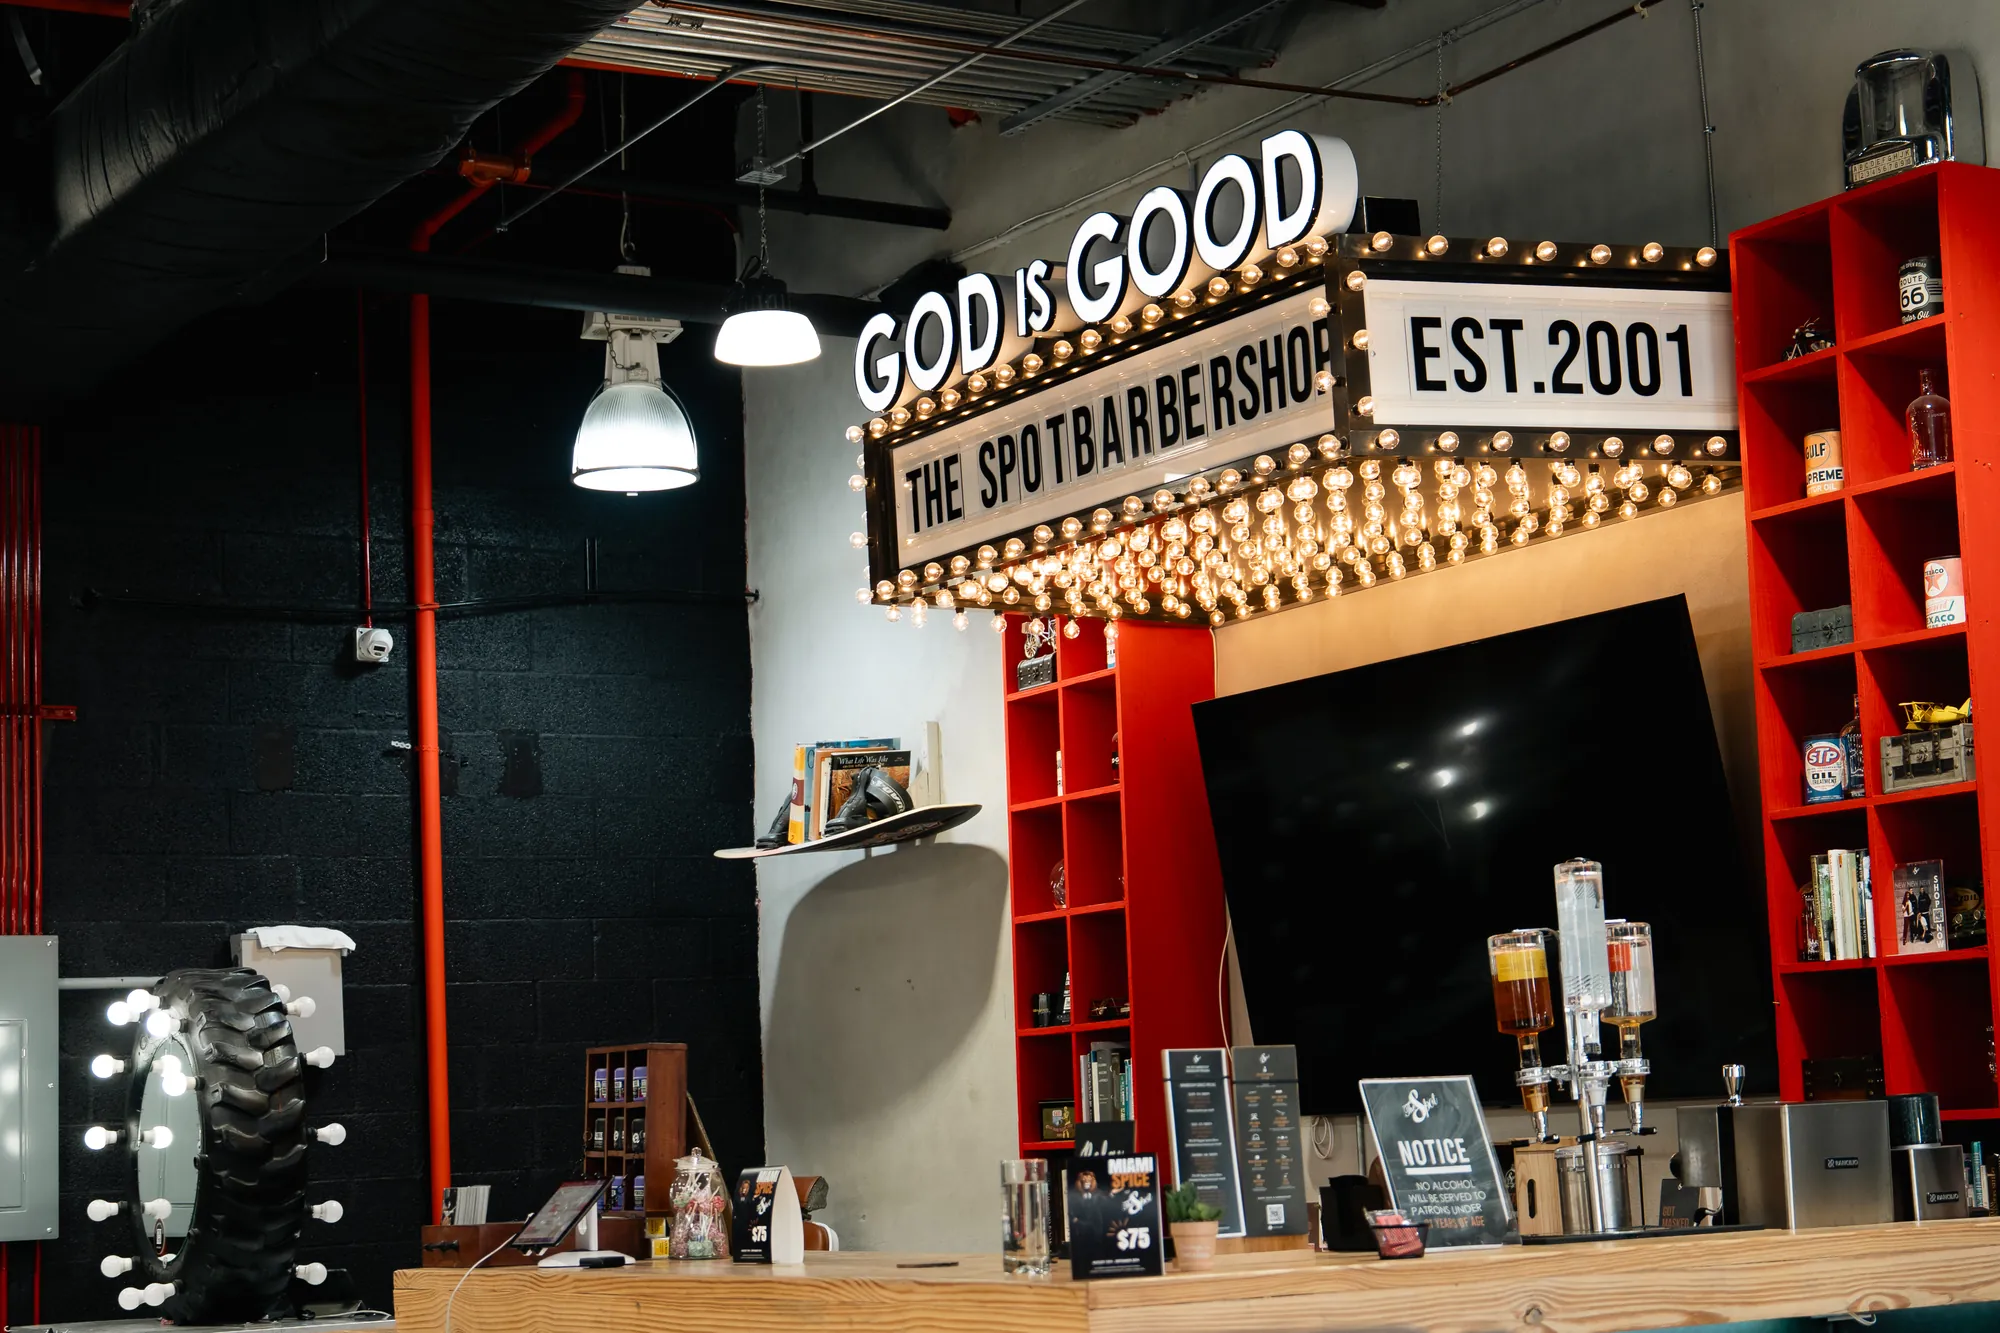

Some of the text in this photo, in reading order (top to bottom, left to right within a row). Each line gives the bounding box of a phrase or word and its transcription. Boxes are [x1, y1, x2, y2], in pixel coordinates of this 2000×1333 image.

[854, 128, 1324, 412] GOD IS GOOD
[1901, 286, 1925, 308] 66
[1410, 316, 1694, 398] EST.2001
[1805, 443, 1826, 460] GULF
[1807, 469, 1844, 485] PREME
[905, 452, 963, 534] THE
[1808, 747, 1838, 764] STP
[1811, 771, 1837, 780] OIL
[1933, 875, 1941, 908] SHOP
[1936, 923, 1945, 949] NOW
[1397, 1138, 1471, 1167] NOTICE
[1107, 1156, 1154, 1175] MIAMI
[1111, 1172, 1150, 1190] SPICE
[1415, 1179, 1476, 1191] NO ALCOHOL
[1408, 1190, 1487, 1204] WILL BE SERVED TO
[1410, 1202, 1483, 1217] PATRONS UNDER
[1662, 1205, 1676, 1217] GOT
[1434, 1216, 1459, 1229] YEARS
[1459, 1215, 1469, 1228] OF
[1470, 1214, 1486, 1227] AGE
[751, 1225, 768, 1243] $75
[1116, 1226, 1151, 1251] $75
